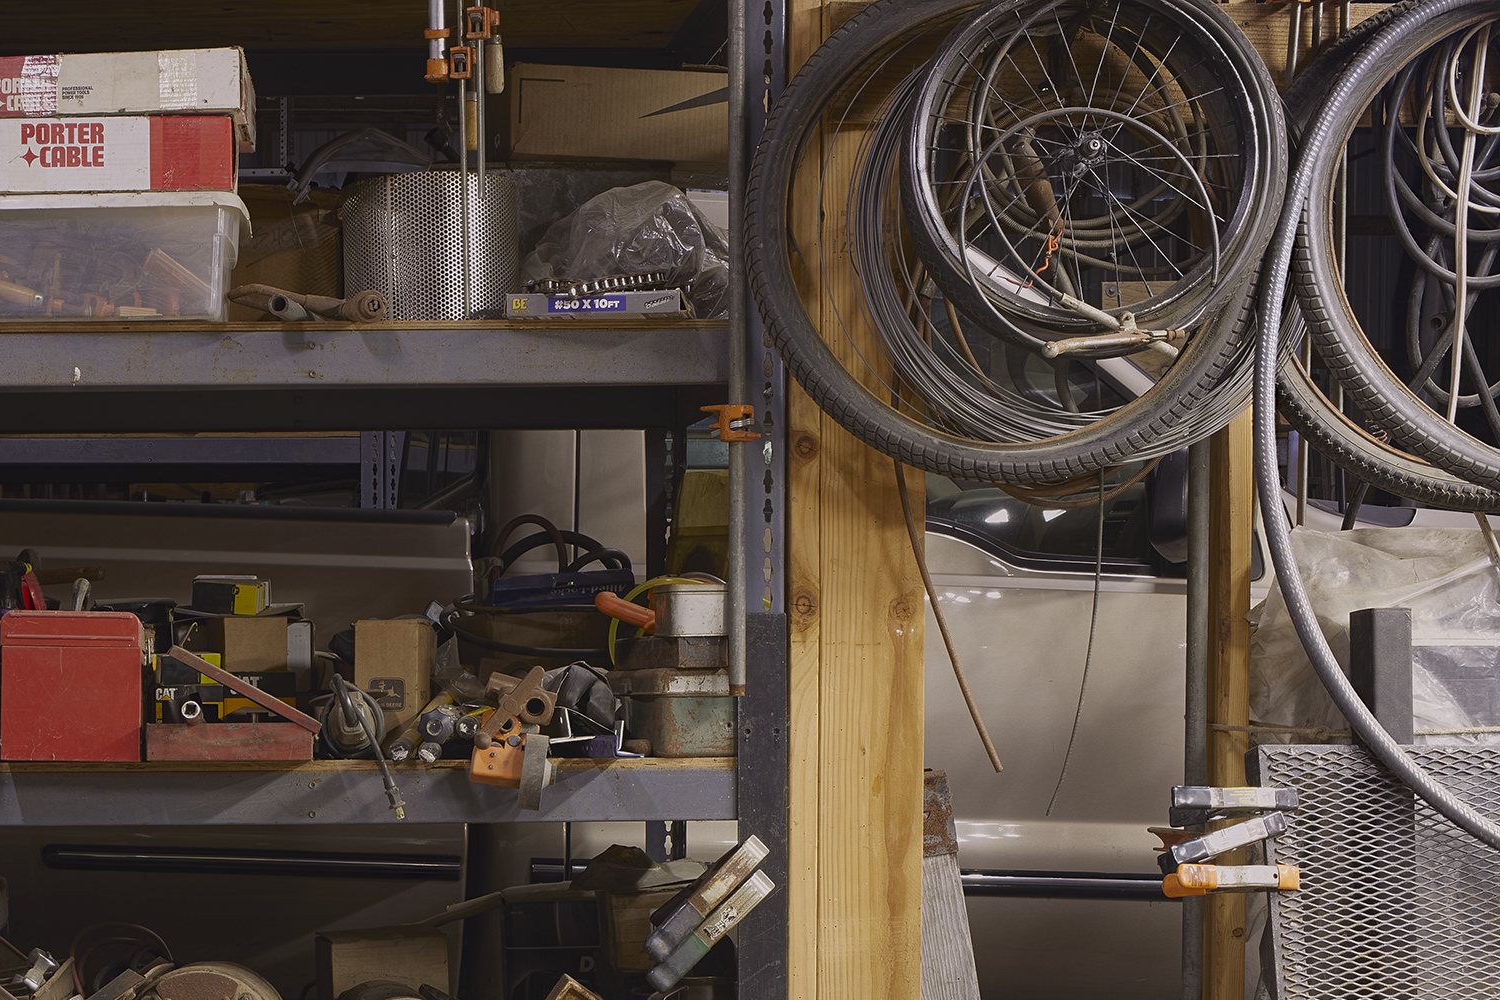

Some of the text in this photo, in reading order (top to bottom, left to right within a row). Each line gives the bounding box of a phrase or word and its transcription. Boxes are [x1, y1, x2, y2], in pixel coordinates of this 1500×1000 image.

[21, 123, 104, 145] PORTER
[39, 146, 104, 168] CABLE
[554, 298, 620, 310] #50 X 10FT
[550, 583, 626, 596] Allied-Locke
[155, 687, 177, 701] CAT
